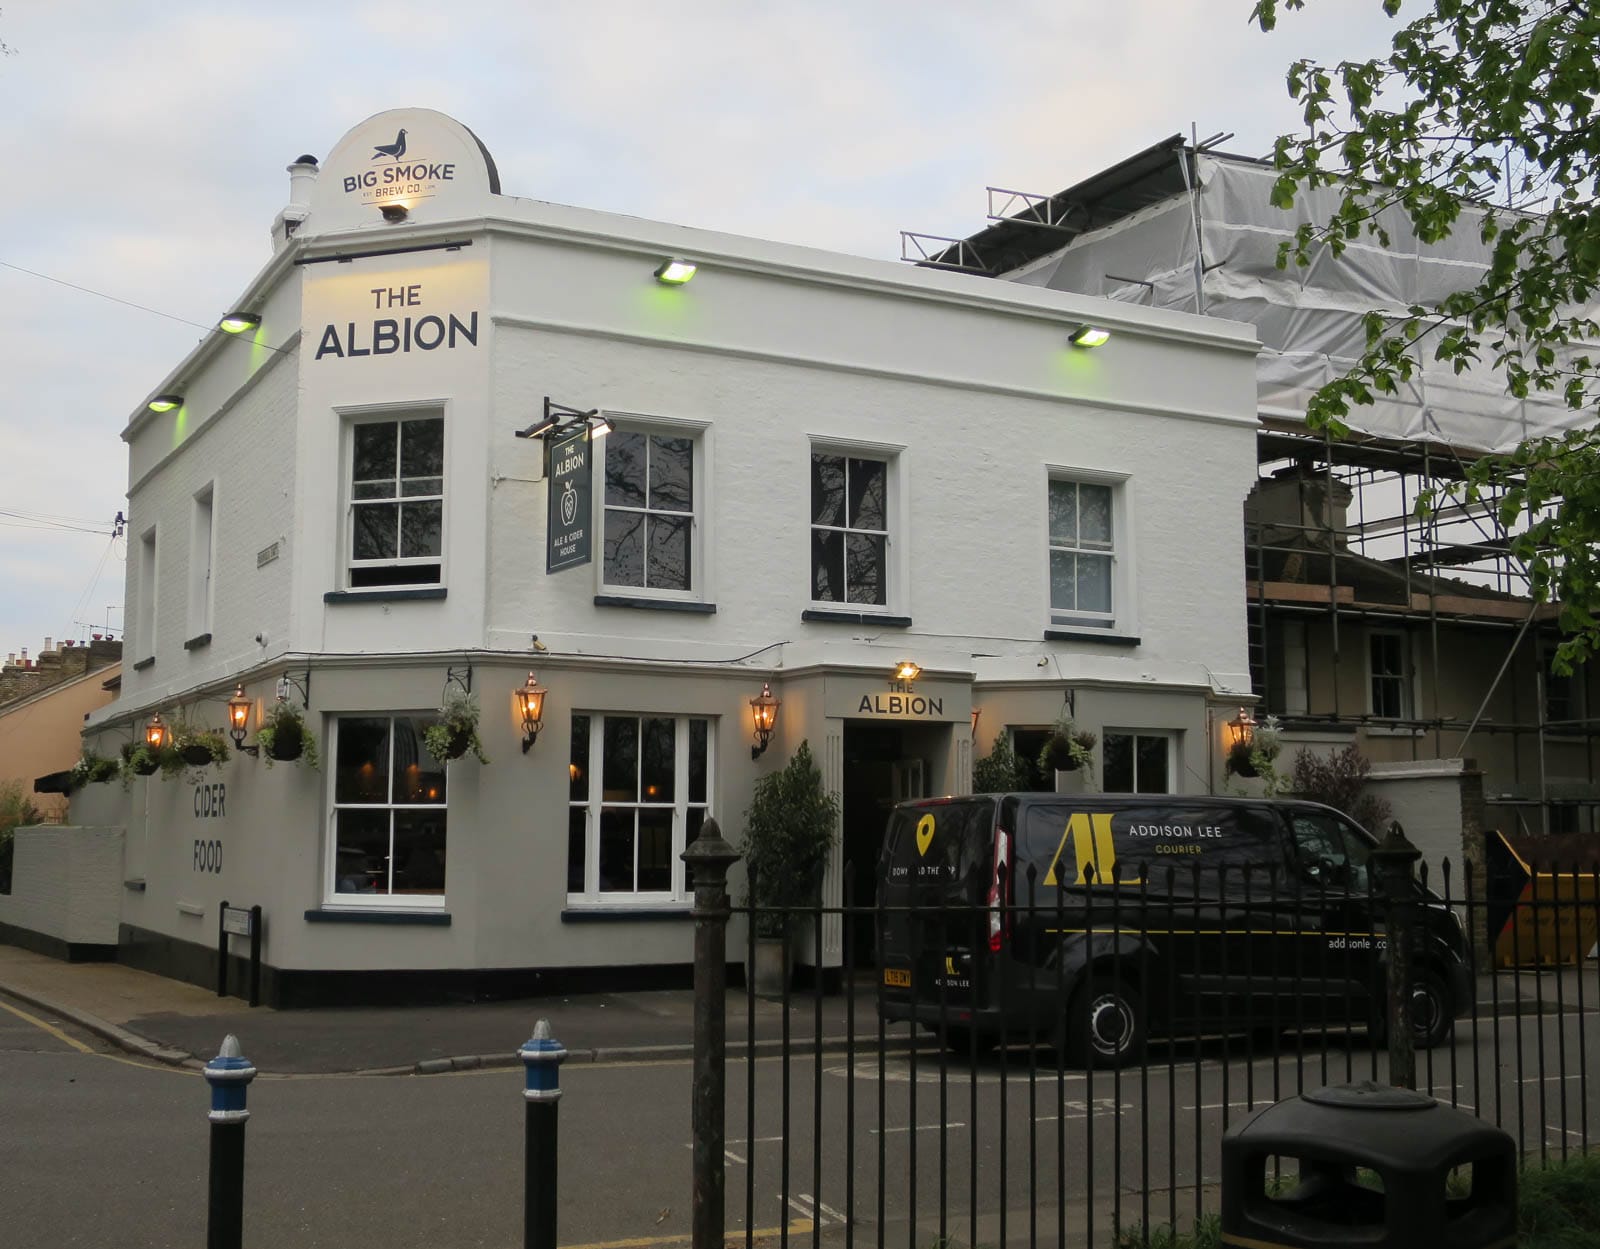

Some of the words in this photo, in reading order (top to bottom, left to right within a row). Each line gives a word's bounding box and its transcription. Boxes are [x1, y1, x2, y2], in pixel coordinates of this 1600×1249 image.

[343, 171, 377, 193] BIG
[383, 163, 455, 184] SMOKE
[375, 185, 404, 198] BREW
[407, 183, 423, 194] CO.
[371, 284, 422, 309] THE
[315, 311, 478, 360] ALBION
[564, 444, 575, 456] THE
[555, 452, 584, 478] ALBION
[554, 537, 564, 547] ALE
[568, 529, 584, 541] CIDER
[559, 545, 576, 557] HOUSE
[888, 682, 914, 694] THE
[858, 695, 943, 716] ALBION
[194, 783, 226, 818] CIDER
[1129, 825, 1193, 838] ADDISON
[1198, 826, 1222, 839] LEE
[193, 840, 223, 874] FOOD
[1155, 845, 1202, 855] COURIER
[927, 865, 940, 876] THE
[959, 979, 970, 988] LEE
